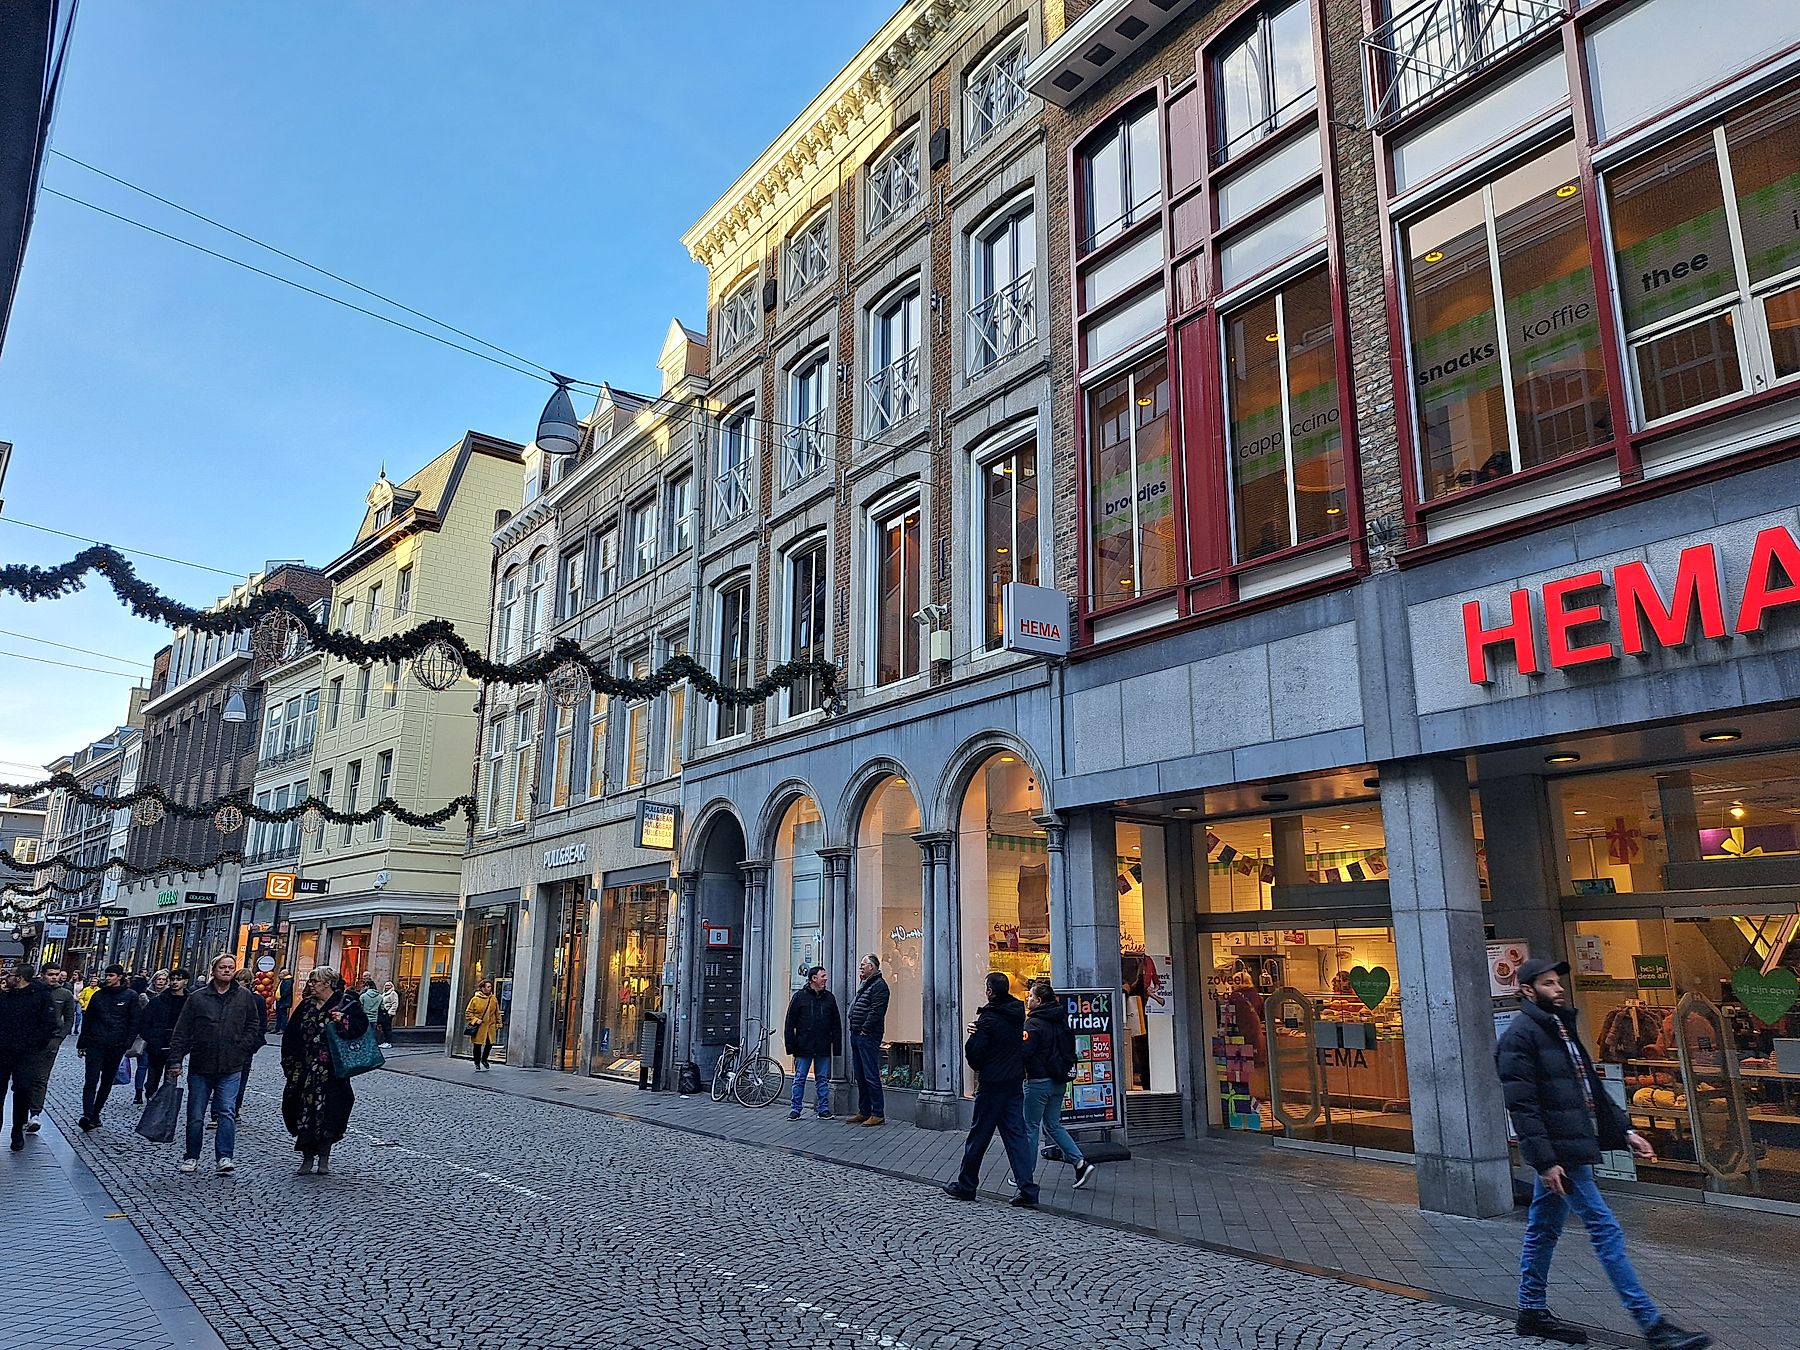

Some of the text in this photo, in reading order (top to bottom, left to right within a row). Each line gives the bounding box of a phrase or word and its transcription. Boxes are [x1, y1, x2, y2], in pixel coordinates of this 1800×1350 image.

[1641, 253, 1709, 292] thee
[1523, 301, 1590, 343] koffie
[1419, 343, 1495, 385] snacks
[1240, 408, 1340, 459] cappccino
[1462, 525, 1800, 684] HEMA
[1020, 618, 1061, 639] HEMA
[644, 805, 674, 815] PULL&BEAR
[644, 812, 673, 823] PULL&BEAR
[543, 843, 587, 868] PULL&BEAR
[300, 881, 319, 891] WE
[1207, 973, 1244, 985] zoveel
[1752, 985, 1768, 995] zijn
[1769, 987, 1795, 1000] open
[1067, 994, 1109, 1014] black
[1067, 1014, 1110, 1031] friday
[1093, 1042, 1109, 1051] 50%
